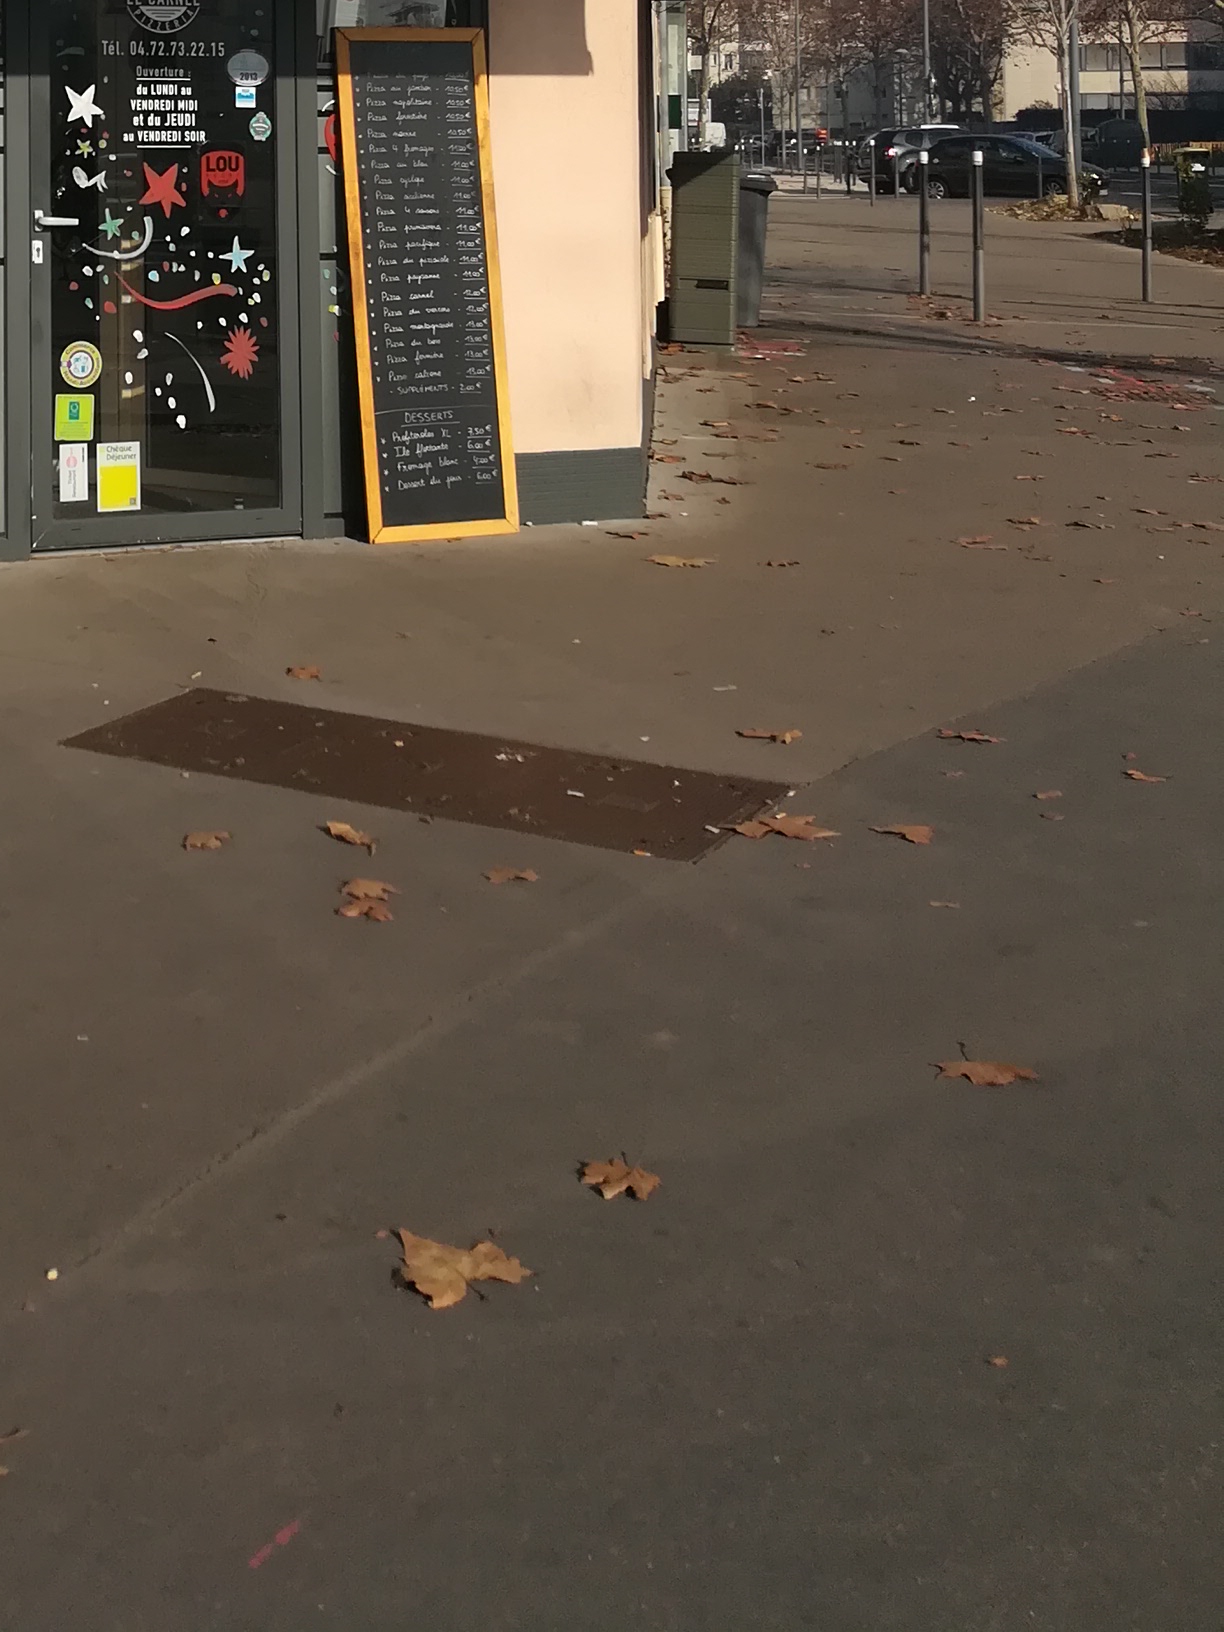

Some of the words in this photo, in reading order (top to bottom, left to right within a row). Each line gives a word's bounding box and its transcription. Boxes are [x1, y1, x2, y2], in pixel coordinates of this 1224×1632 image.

[134, 8, 195, 30] PIZZERIA
[102, 40, 124, 56] Tél.
[130, 41, 225, 57] 04.72.73.22.15
[136, 66, 184, 77] Ouverture
[136, 84, 148, 95] du
[151, 84, 177, 95] LUNDI
[181, 86, 192, 95] au
[130, 100, 175, 111] VENDREDI
[177, 100, 198, 111] MIDI
[133, 115, 145, 127] et
[147, 114, 160, 127] du
[164, 114, 195, 127] JEUDI
[123, 132, 134, 142] au
[137, 130, 181, 142] VENDREDI
[184, 130, 206, 142] SOIR
[206, 156, 239, 172] LOU
[404, 410, 453, 423] DESSERTS
